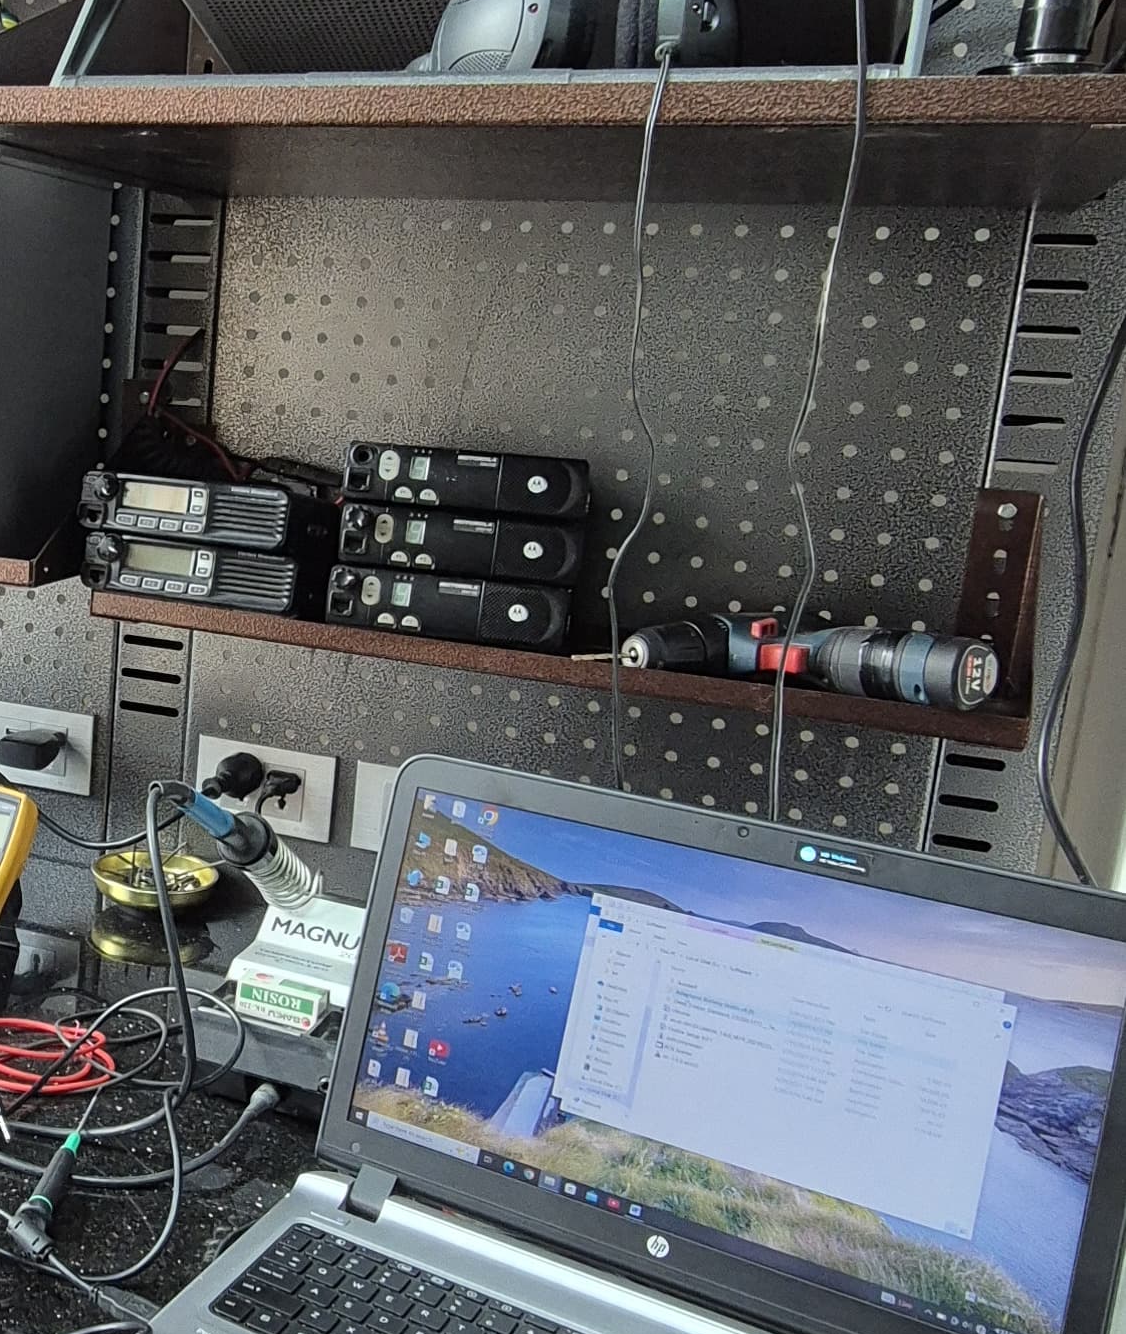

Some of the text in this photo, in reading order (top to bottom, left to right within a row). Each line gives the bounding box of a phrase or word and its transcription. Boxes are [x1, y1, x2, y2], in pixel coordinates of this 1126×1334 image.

[970, 657, 982, 691] 12V
[271, 916, 361, 951] MAGNU
[252, 988, 302, 1011] ROSIN
